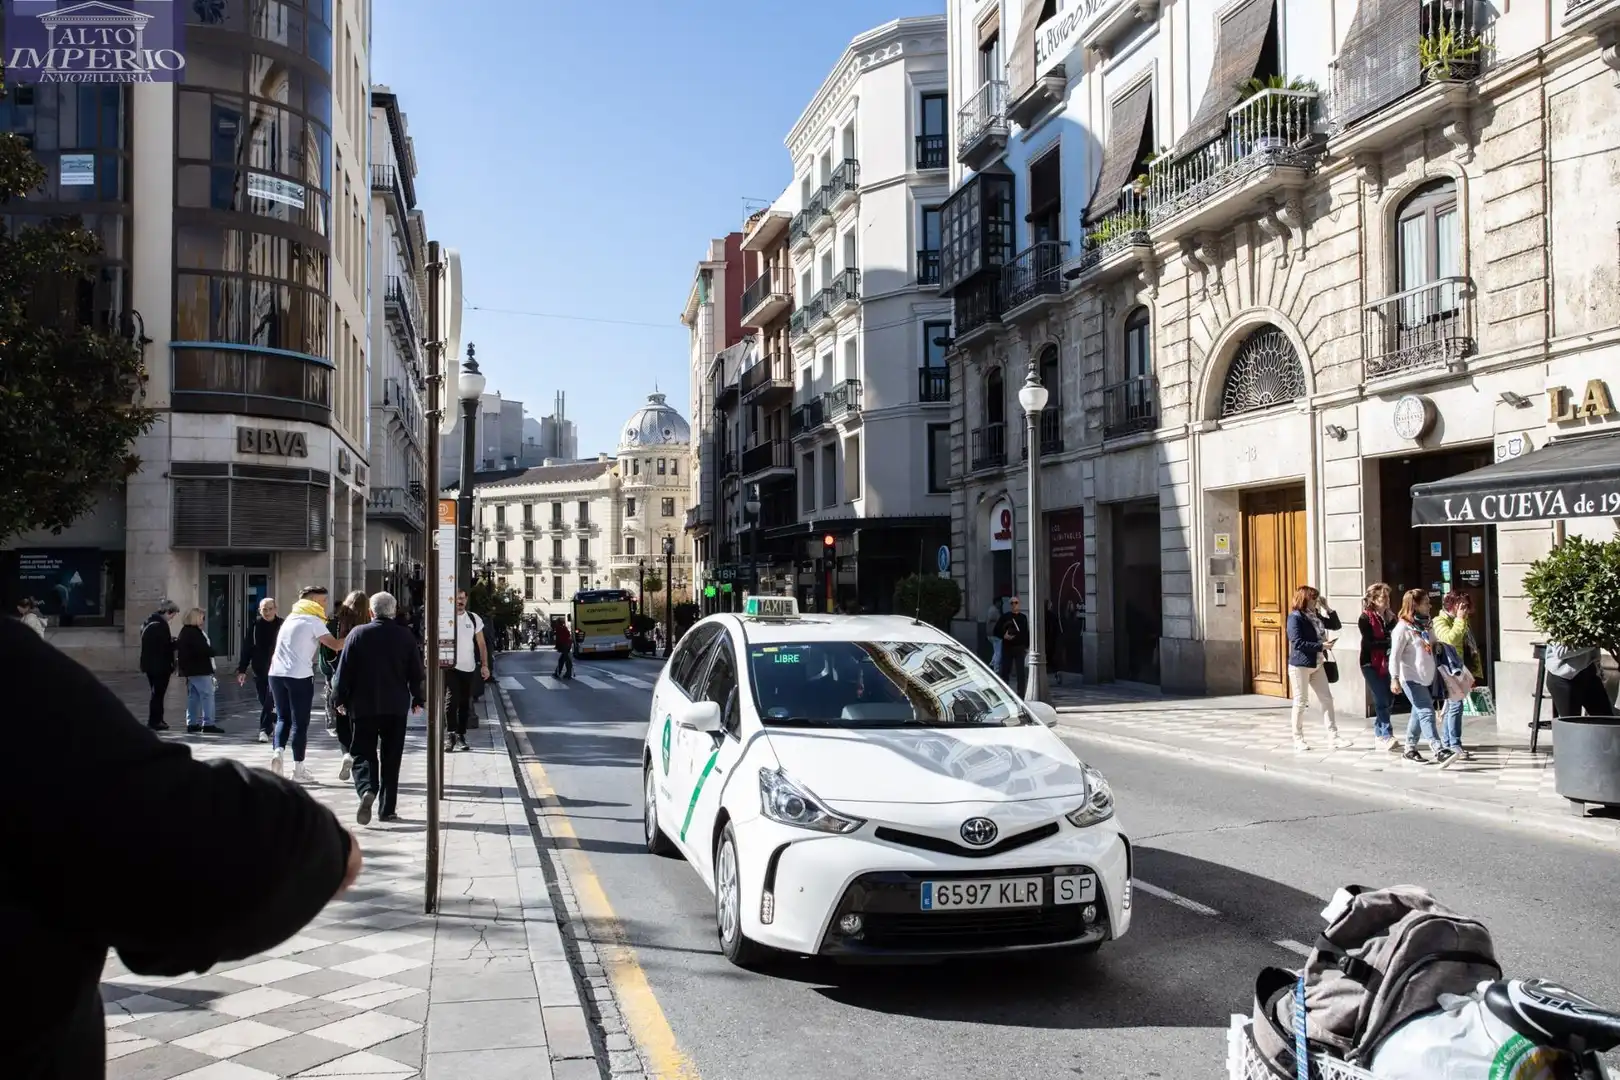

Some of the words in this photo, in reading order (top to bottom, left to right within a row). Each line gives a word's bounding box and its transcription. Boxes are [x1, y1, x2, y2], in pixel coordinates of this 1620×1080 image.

[1047, 4, 1083, 56] RUIDO
[1546, 379, 1617, 423] LA
[237, 426, 308, 458] BBVA
[1444, 497, 1475, 521] LA
[1480, 489, 1569, 519] CUEVA
[1573, 493, 1595, 514] de
[760, 600, 782, 613] TAXI
[774, 654, 800, 663] LIBRE
[937, 884, 992, 906] 6597
[1000, 882, 1039, 904] KLR
[1060, 877, 1092, 900] SP
